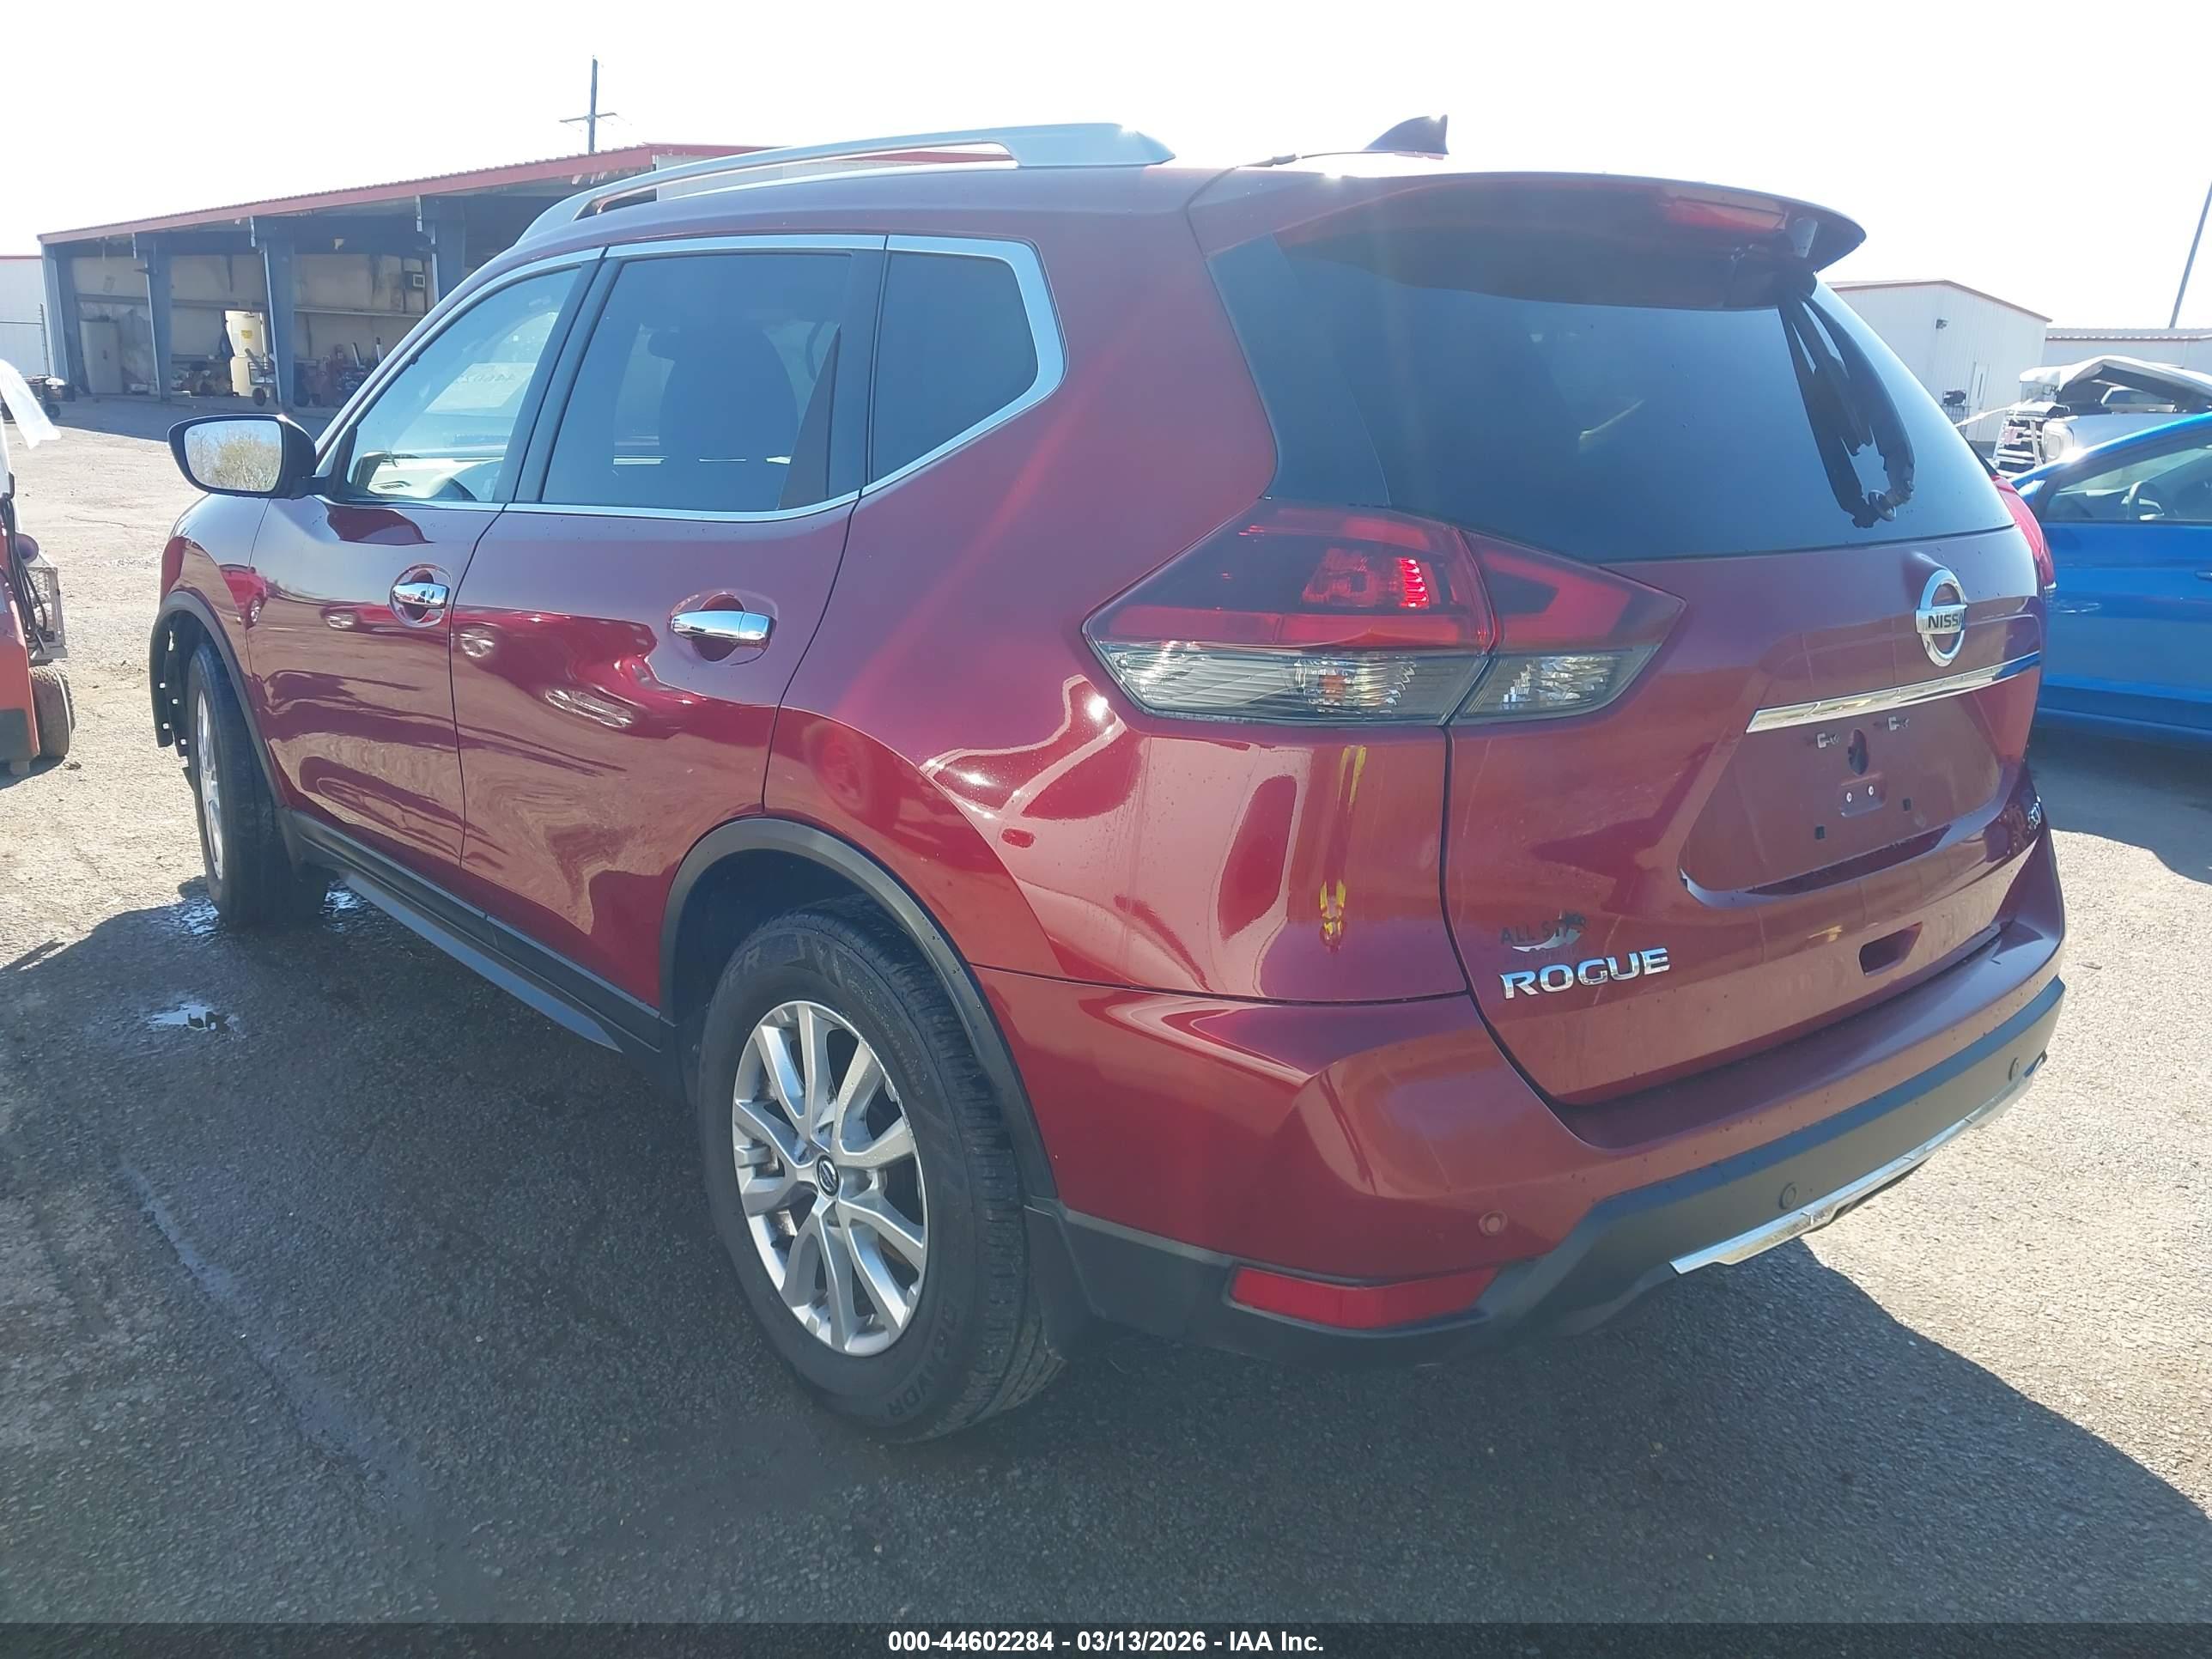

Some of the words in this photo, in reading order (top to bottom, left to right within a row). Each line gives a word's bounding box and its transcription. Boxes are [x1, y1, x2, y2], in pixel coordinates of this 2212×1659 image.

[1928, 611, 1965, 629] NISSA
[1499, 923, 1536, 945] ALL
[1499, 947, 1671, 1000] ROGUE
